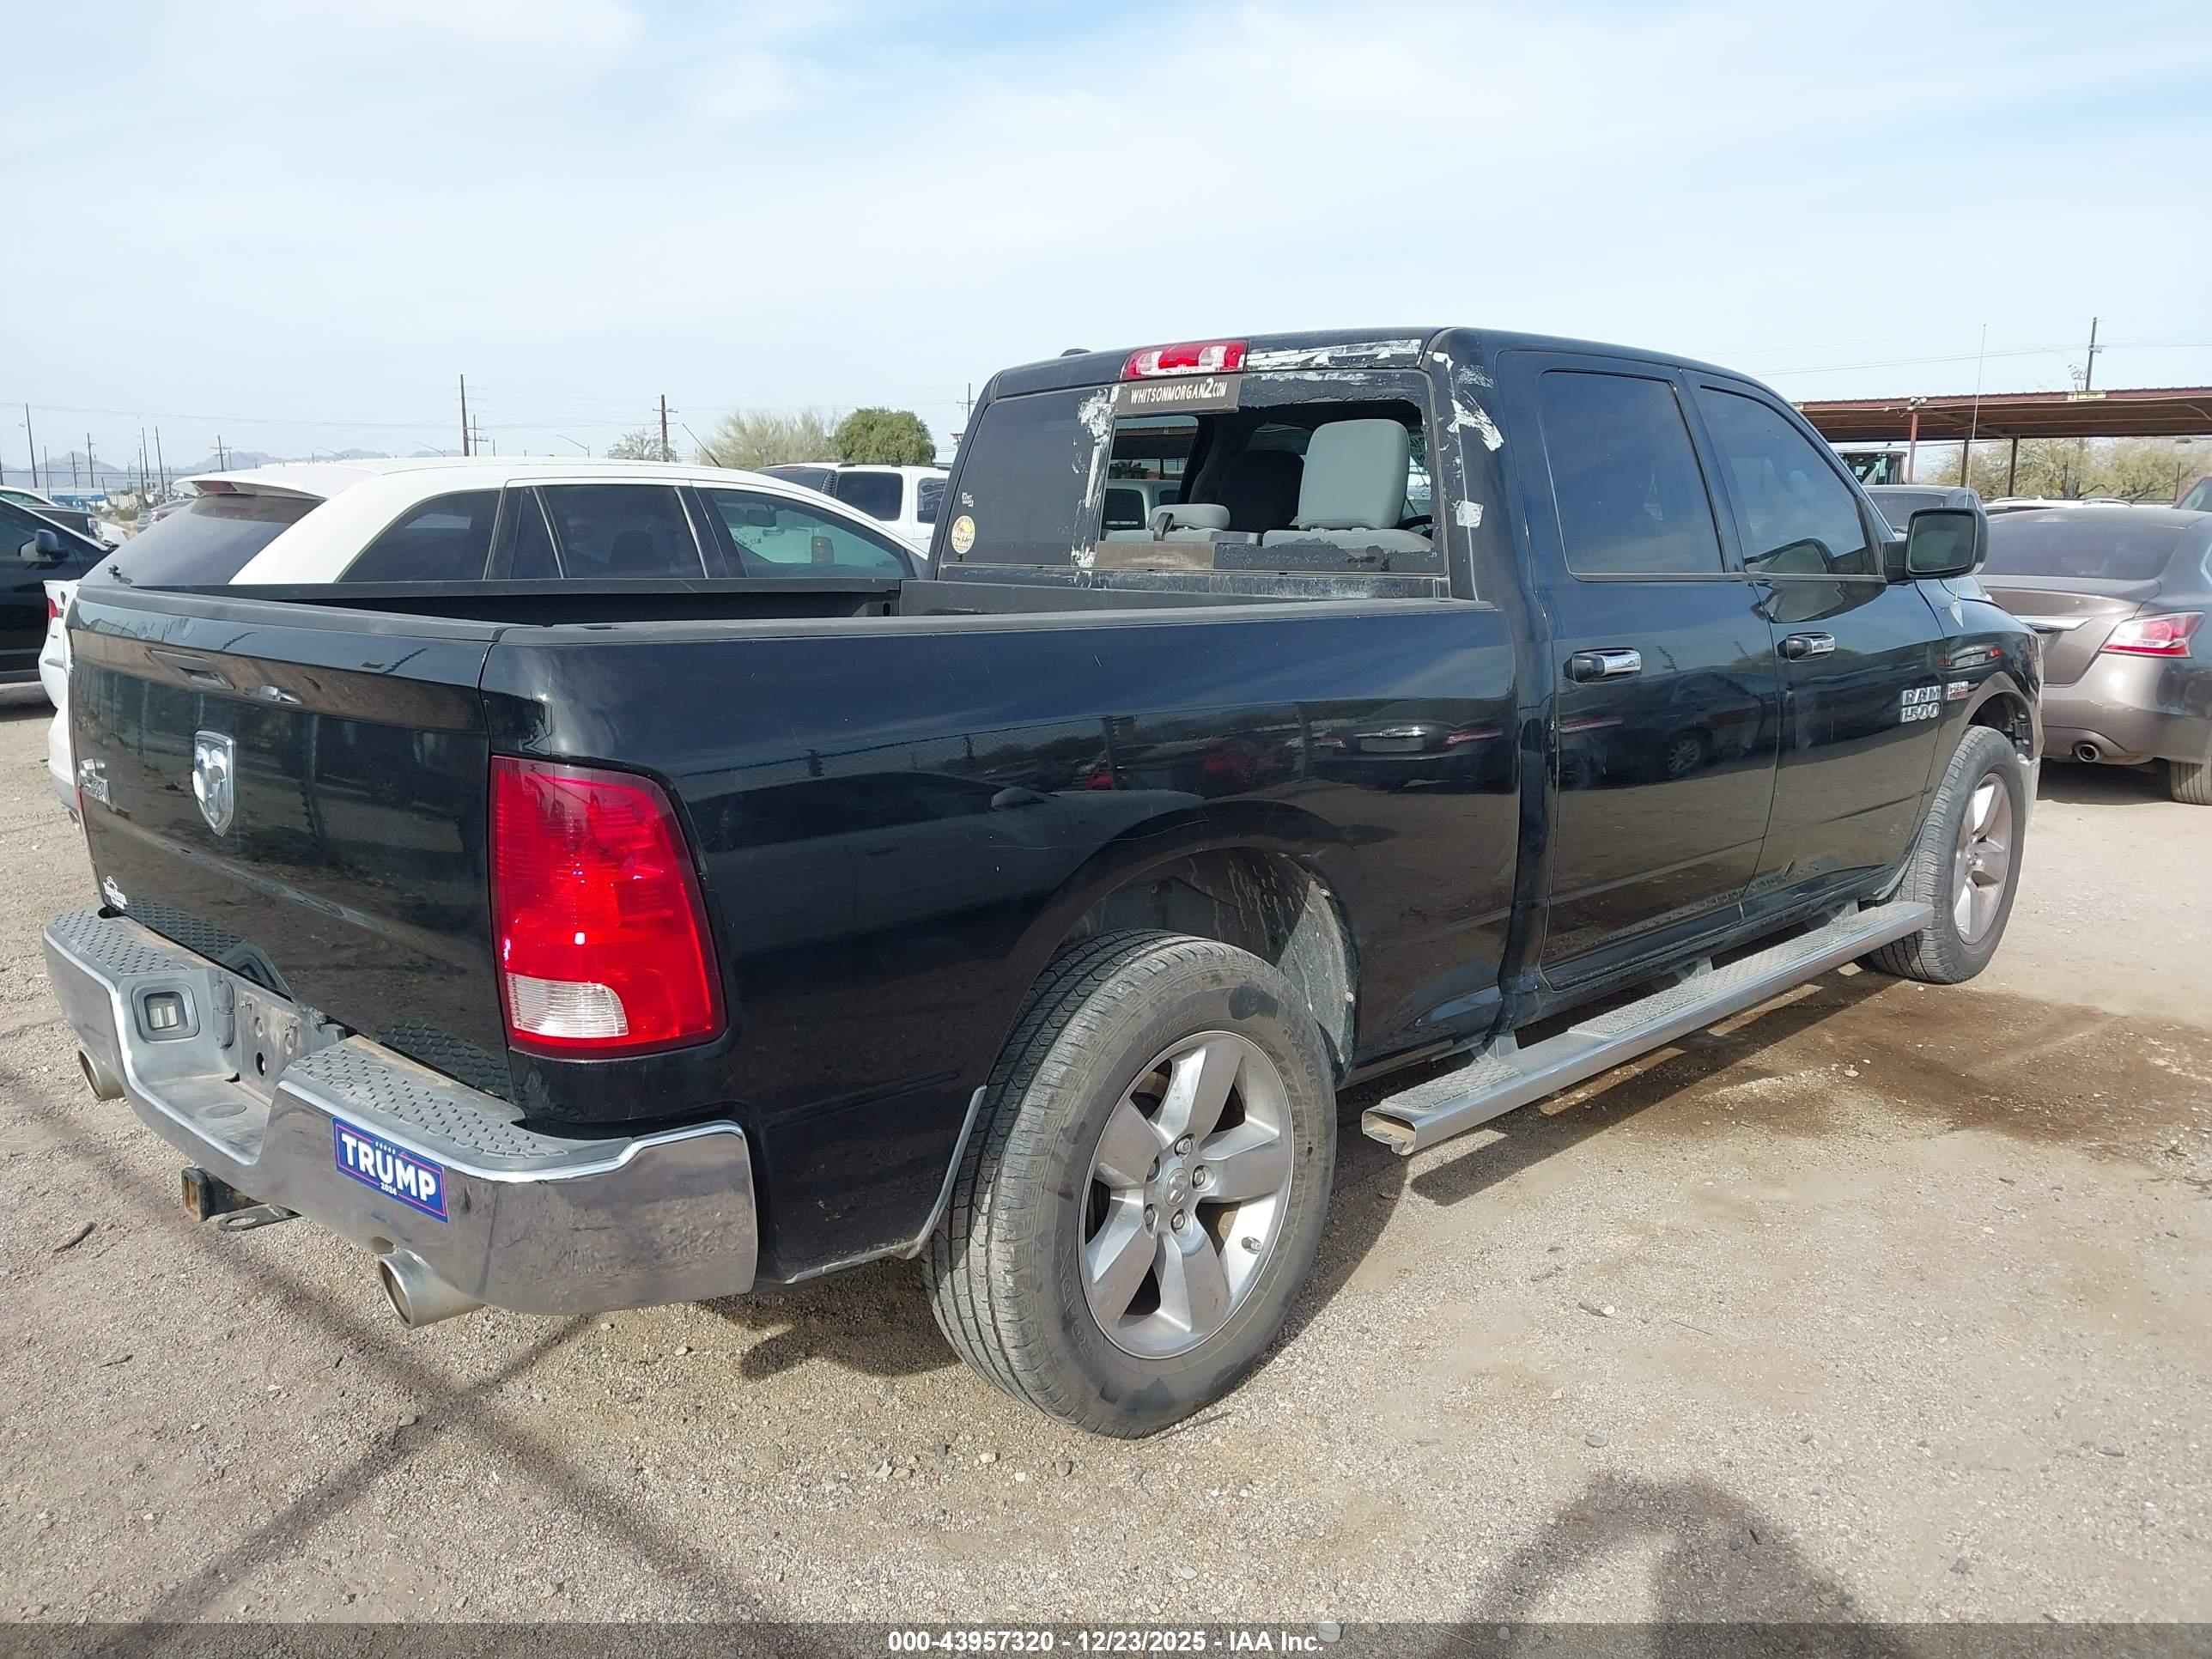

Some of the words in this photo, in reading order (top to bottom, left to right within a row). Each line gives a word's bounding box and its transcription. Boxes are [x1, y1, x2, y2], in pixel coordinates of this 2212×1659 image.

[1902, 685, 1941, 706] RAM
[1901, 702, 1940, 722] 1500
[341, 1133, 436, 1201] TRUMP
[380, 1182, 398, 1195] 2024
